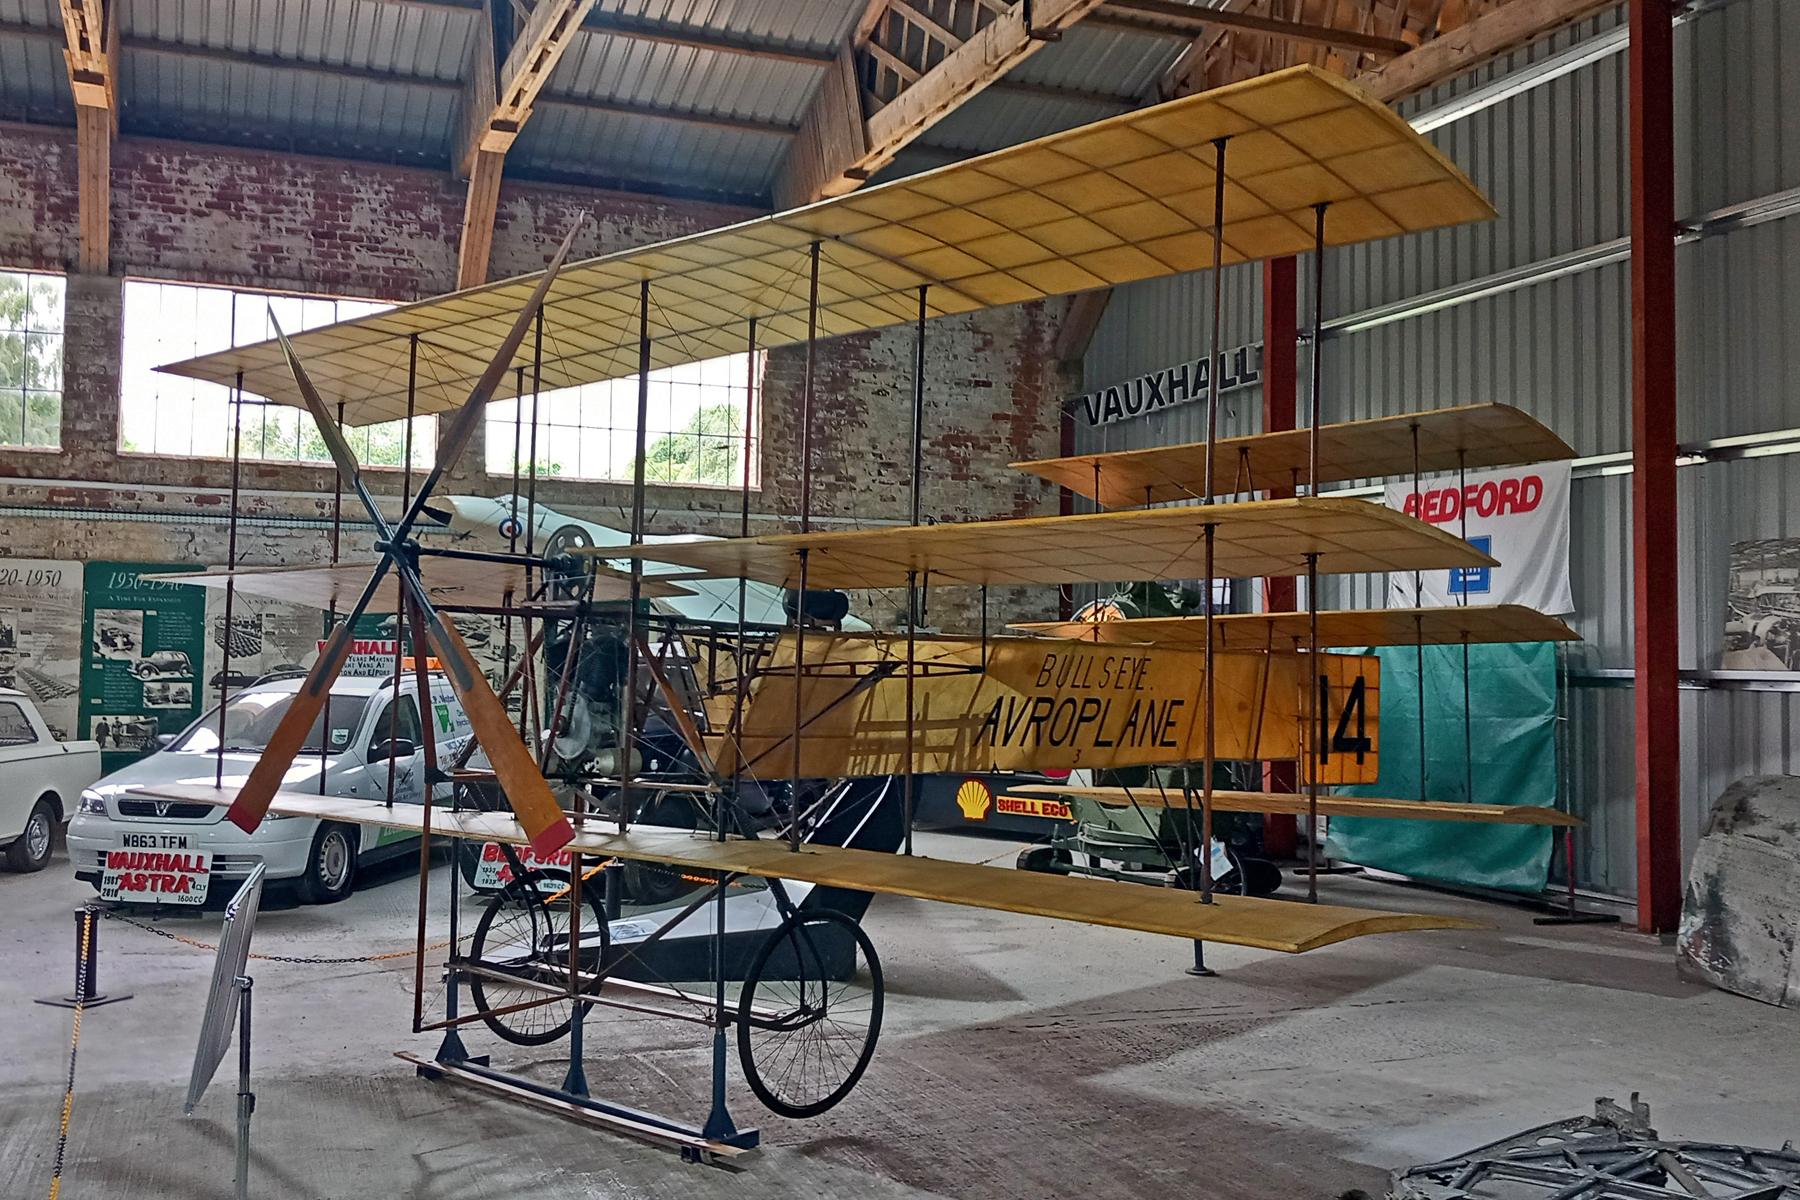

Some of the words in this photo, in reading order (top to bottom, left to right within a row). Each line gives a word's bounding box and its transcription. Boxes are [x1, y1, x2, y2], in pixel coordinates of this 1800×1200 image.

[1083, 346, 1259, 426] VAUXHALL
[1403, 475, 1543, 524] BEDFORD
[973, 695, 1185, 748] AVROPLANE
[1320, 675, 1371, 765] 14
[998, 798, 1039, 815] SHELL
[107, 851, 209, 873] VAUXHALL
[123, 834, 156, 848] W863
[160, 836, 187, 849] TFM
